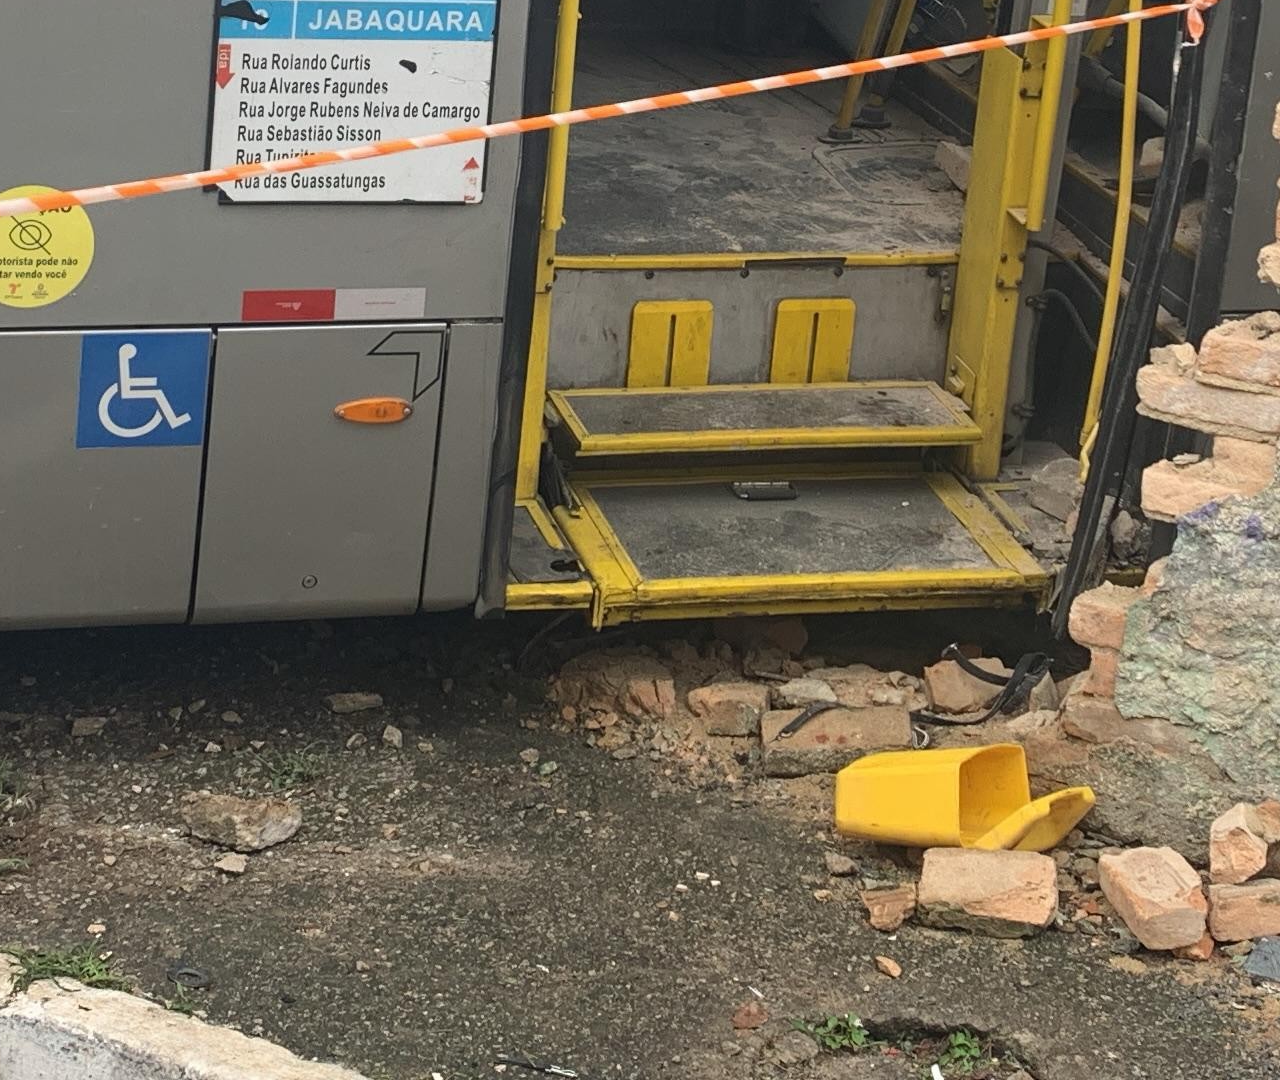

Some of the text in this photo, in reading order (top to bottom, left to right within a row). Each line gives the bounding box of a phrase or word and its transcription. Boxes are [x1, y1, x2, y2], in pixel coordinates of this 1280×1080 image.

[308, 8, 484, 33] JABAQUARA
[242, 53, 371, 71] Rua Rolando Curtis
[240, 77, 389, 98] Rua Alvares Fagundes
[239, 101, 481, 123] Rua Jorge Rubens Neiva de Camargo
[237, 124, 382, 142] Rua Sebastião Sisson
[236, 148, 262, 165] Rua
[234, 172, 386, 192] Rua das Guassatungas
[35, 256, 59, 268] pode
[61, 256, 78, 266] não
[15, 270, 43, 279] vendo
[45, 270, 67, 279] você
